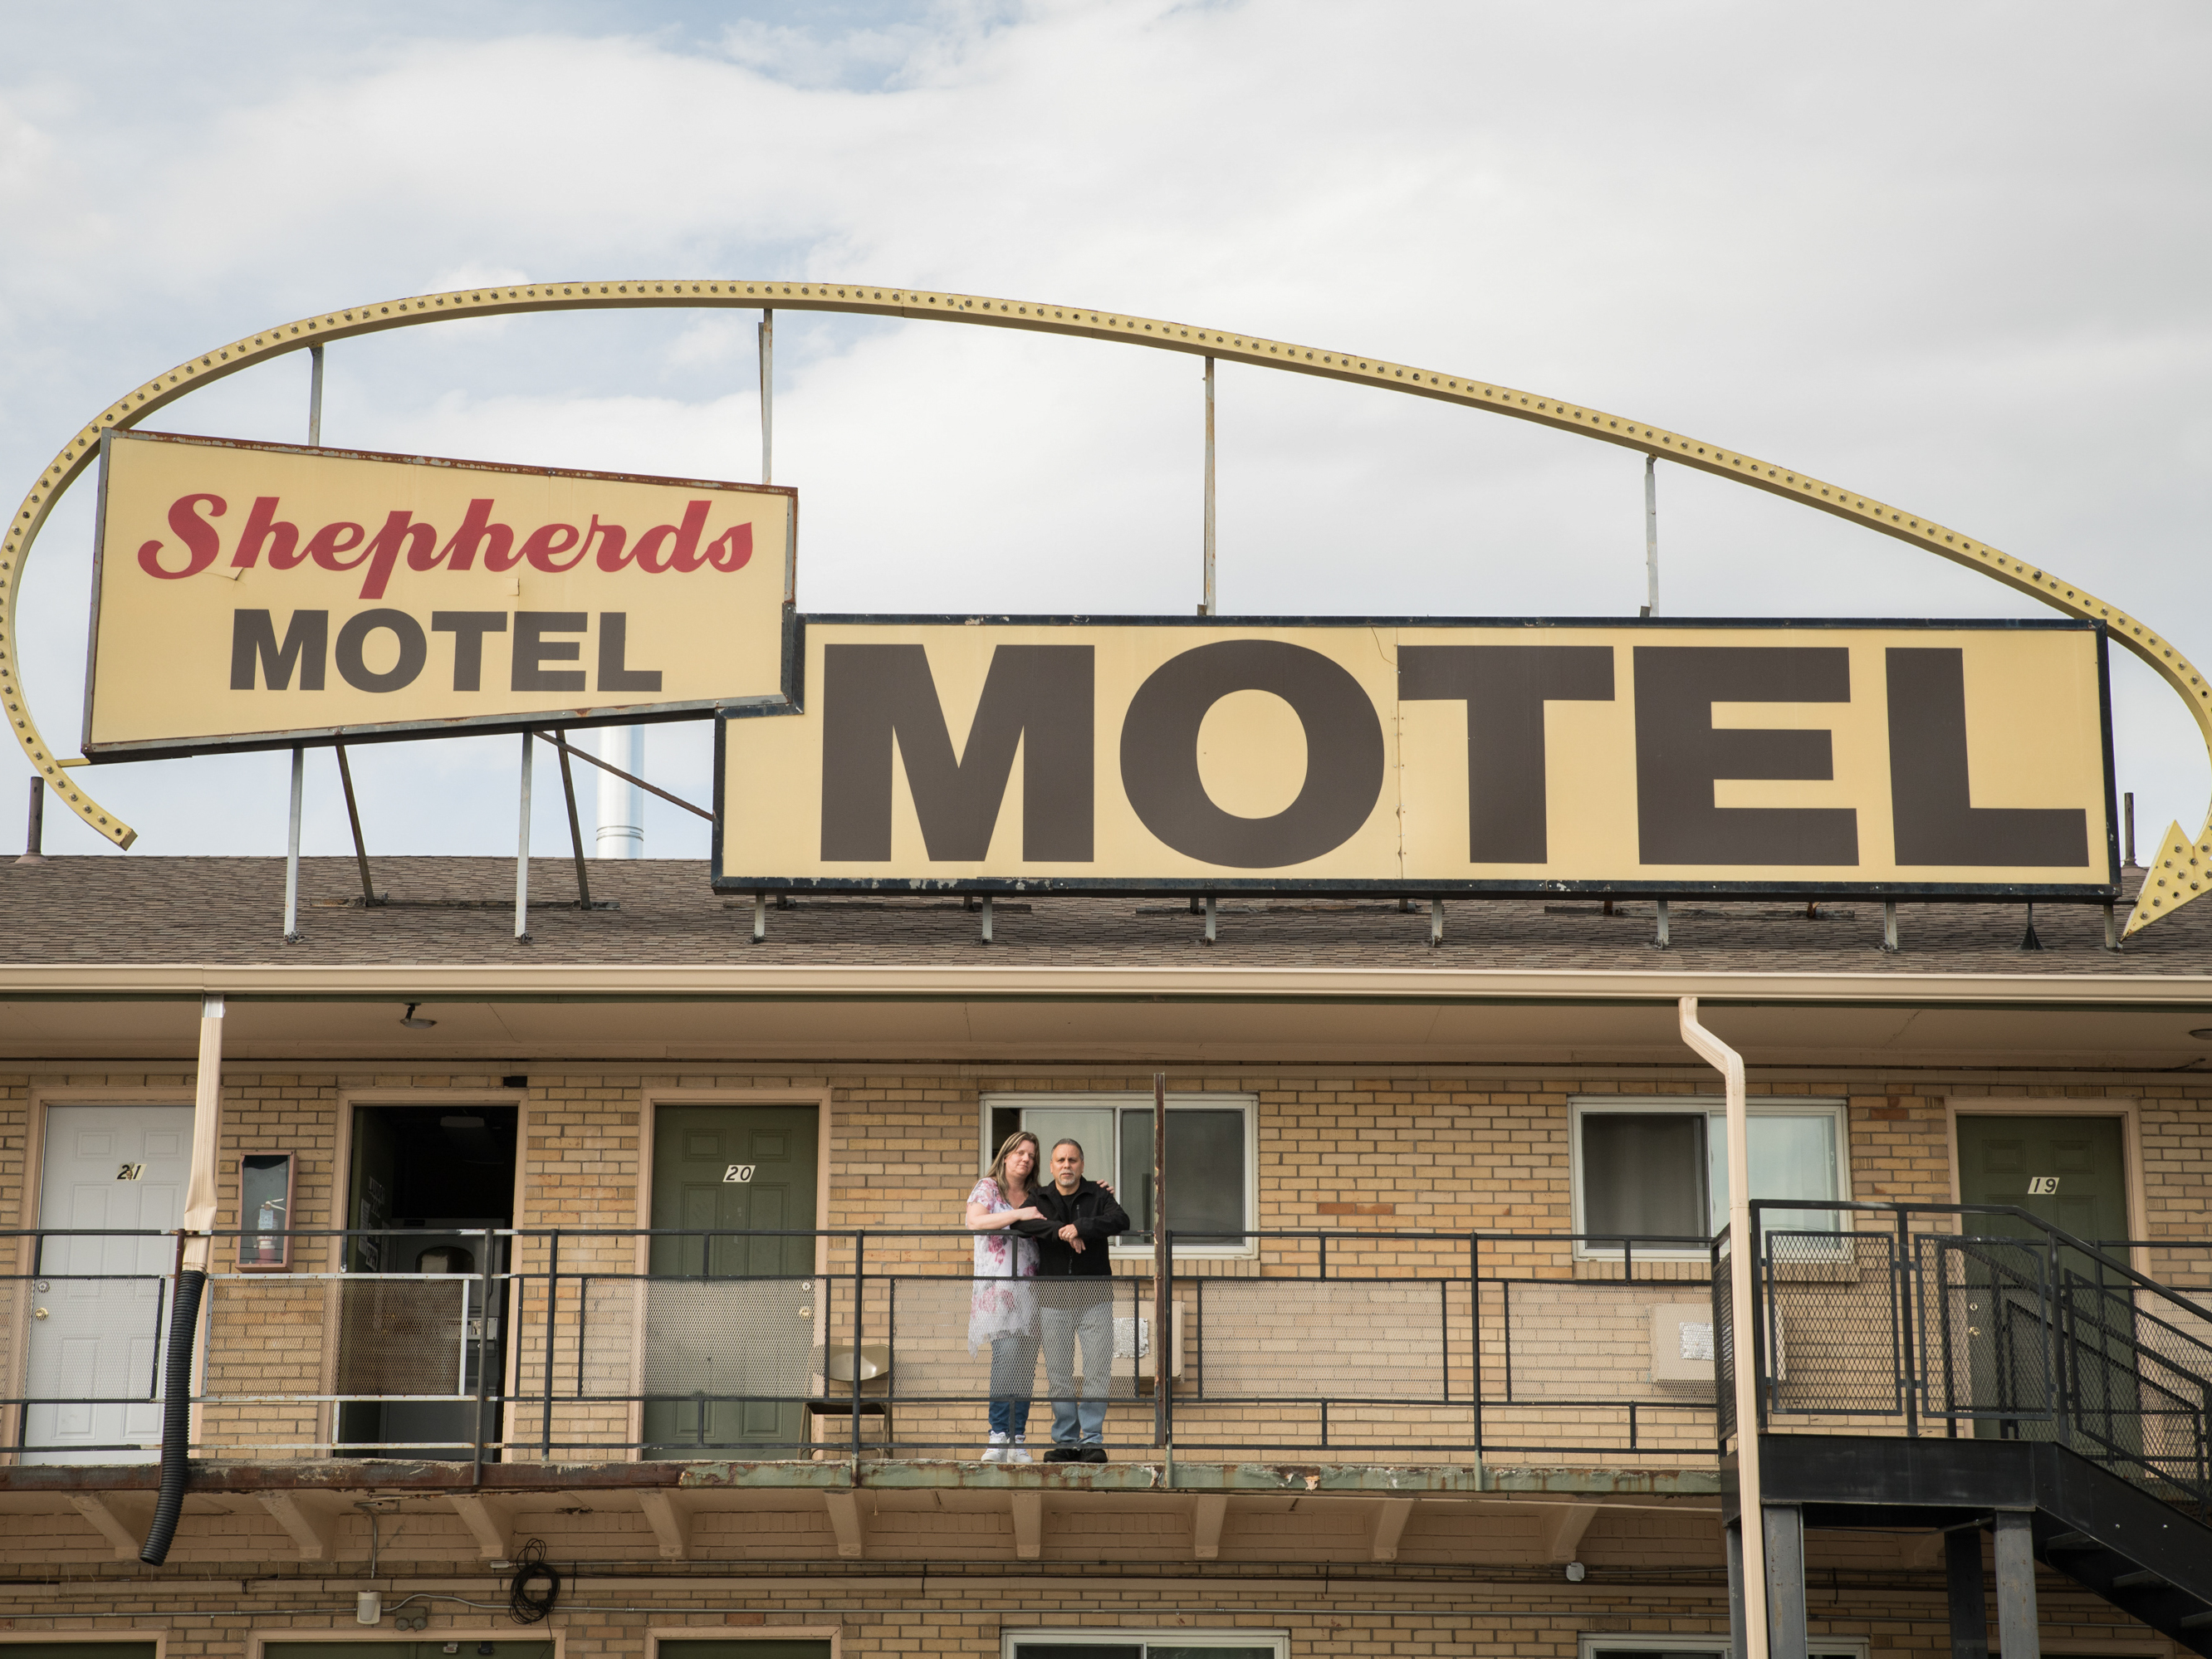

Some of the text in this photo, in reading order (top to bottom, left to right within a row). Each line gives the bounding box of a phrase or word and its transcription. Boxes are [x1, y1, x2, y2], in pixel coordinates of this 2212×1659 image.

[137, 493, 753, 599] Shepherds
[229, 608, 663, 693] MOTEL
[820, 639, 2089, 869] MOTEL
[116, 1164, 142, 1180] 21
[726, 1166, 751, 1181] 20
[2033, 1177, 2057, 1193] 19
